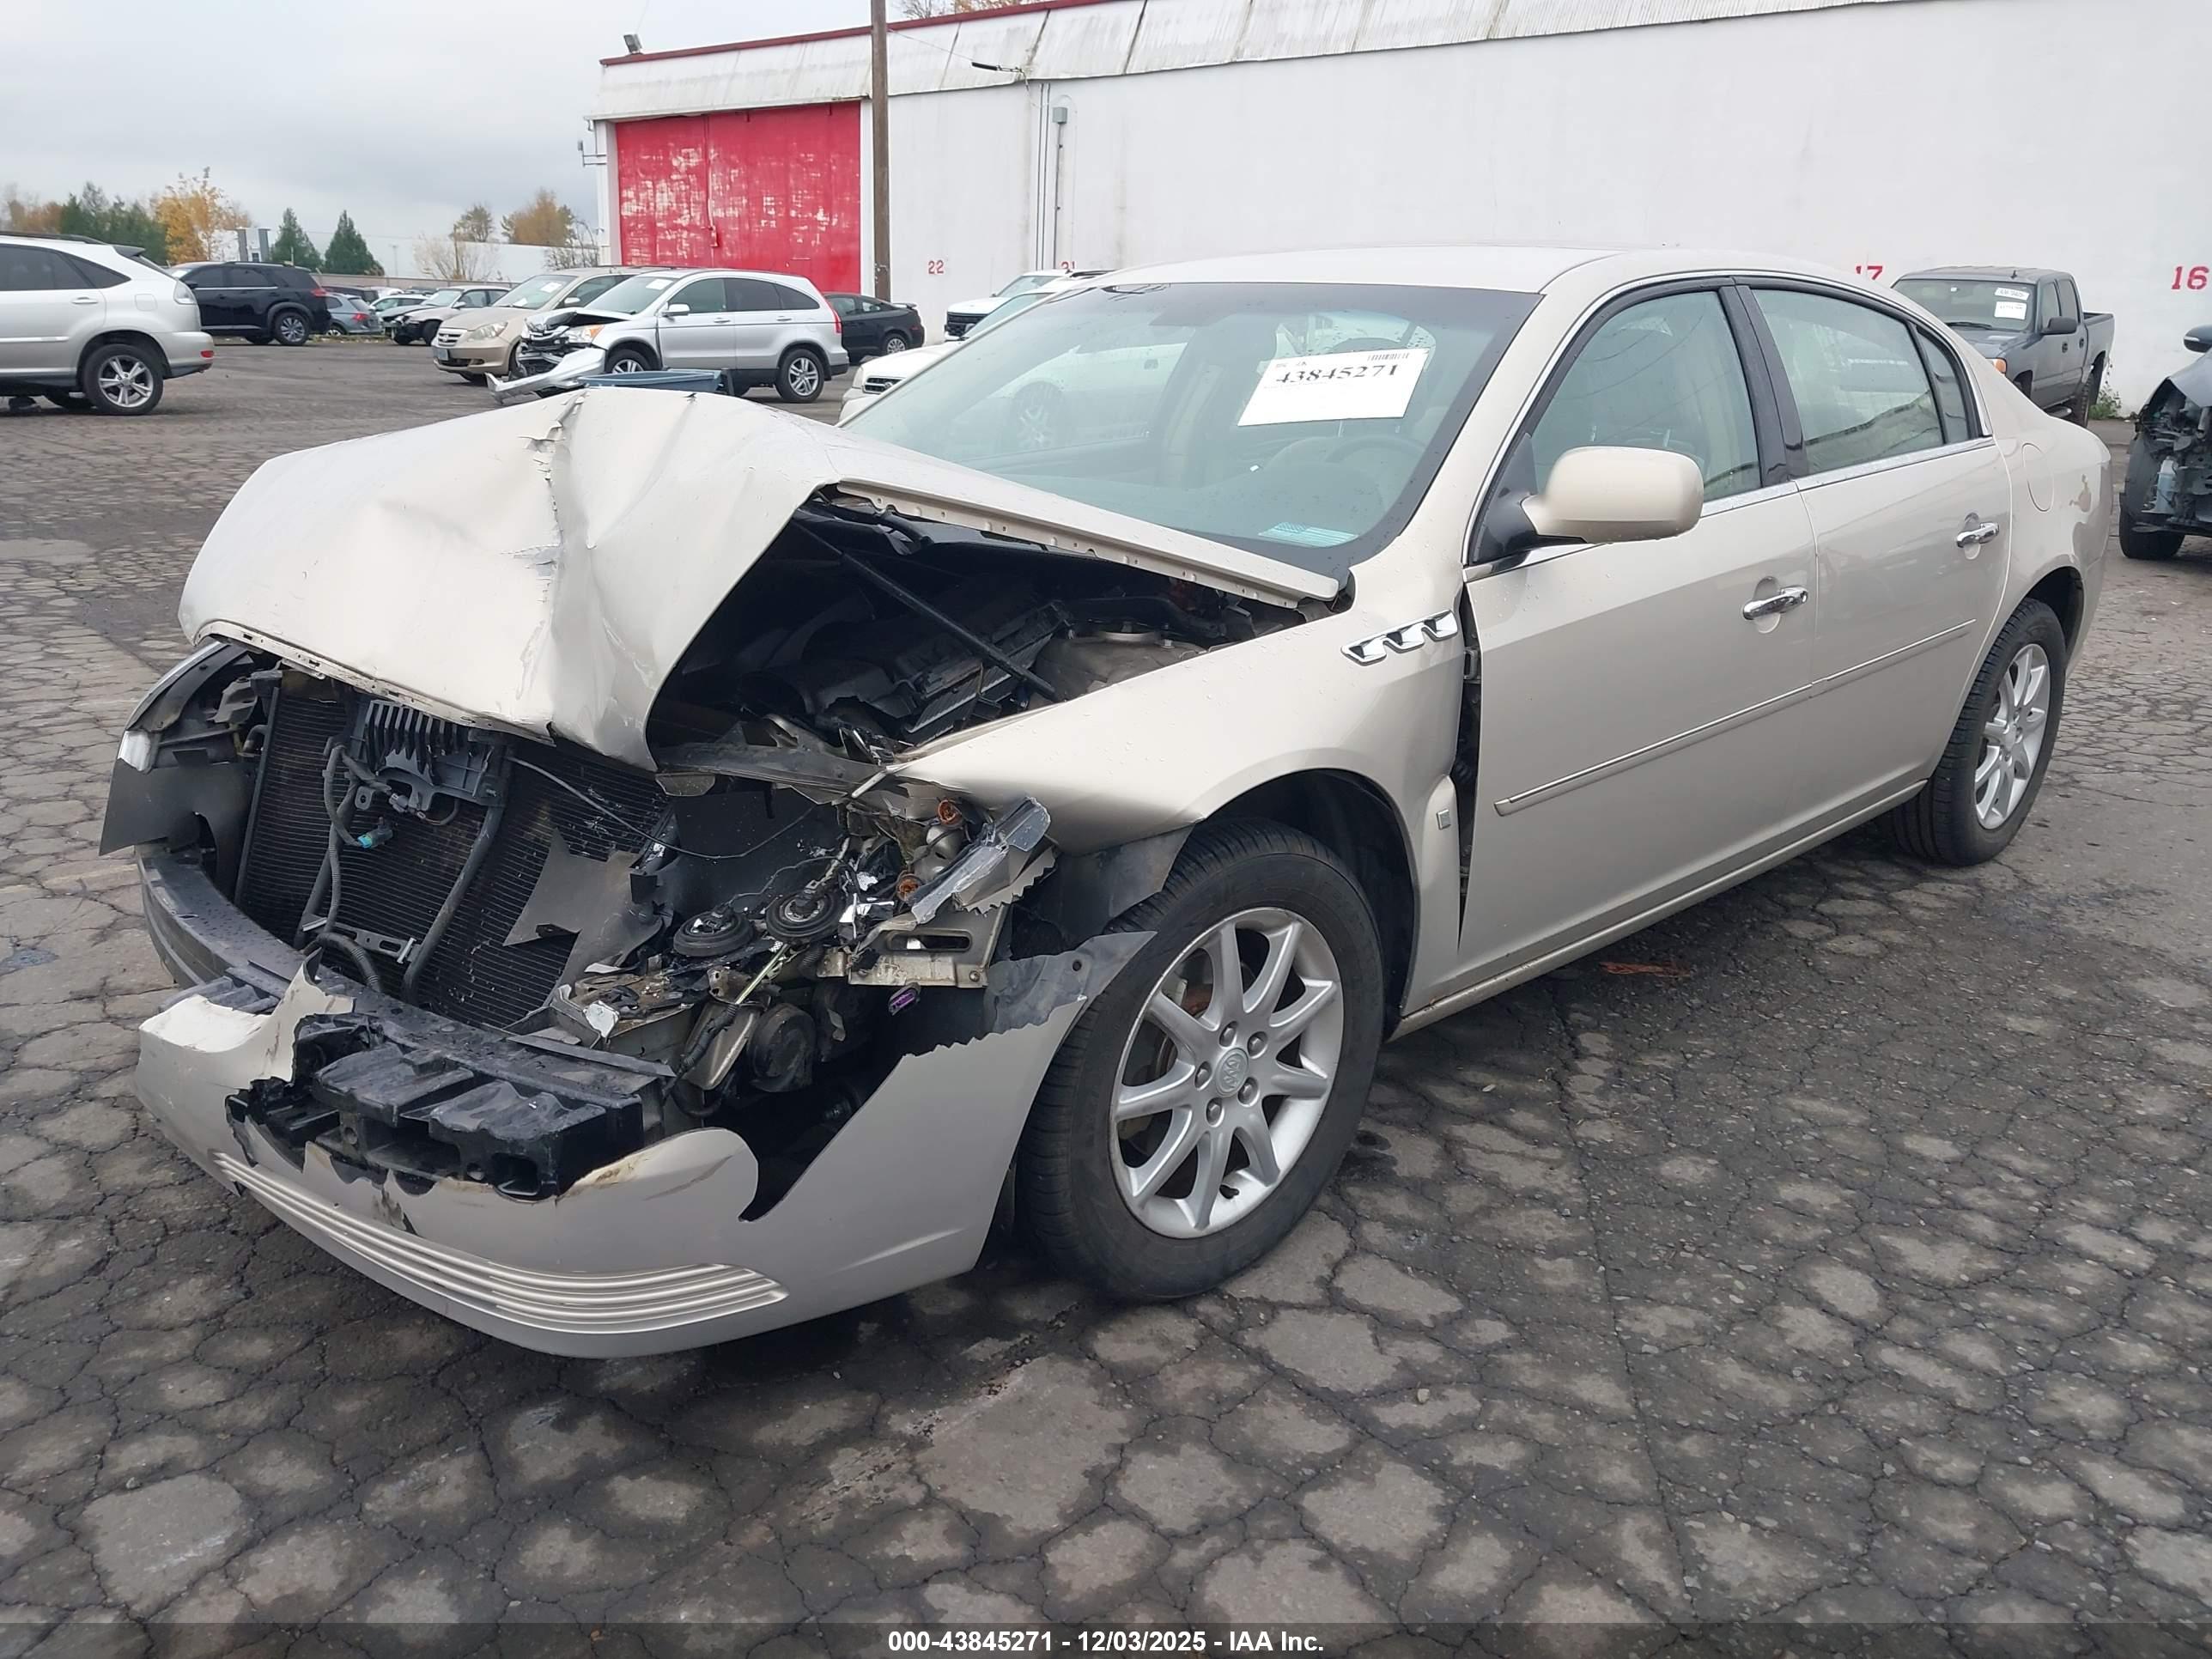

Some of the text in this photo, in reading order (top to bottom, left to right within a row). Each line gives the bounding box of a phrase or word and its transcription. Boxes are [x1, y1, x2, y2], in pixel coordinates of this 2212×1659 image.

[928, 260, 944, 274] 22
[2172, 266, 2209, 290] 16
[1276, 364, 1398, 384] 43845271
